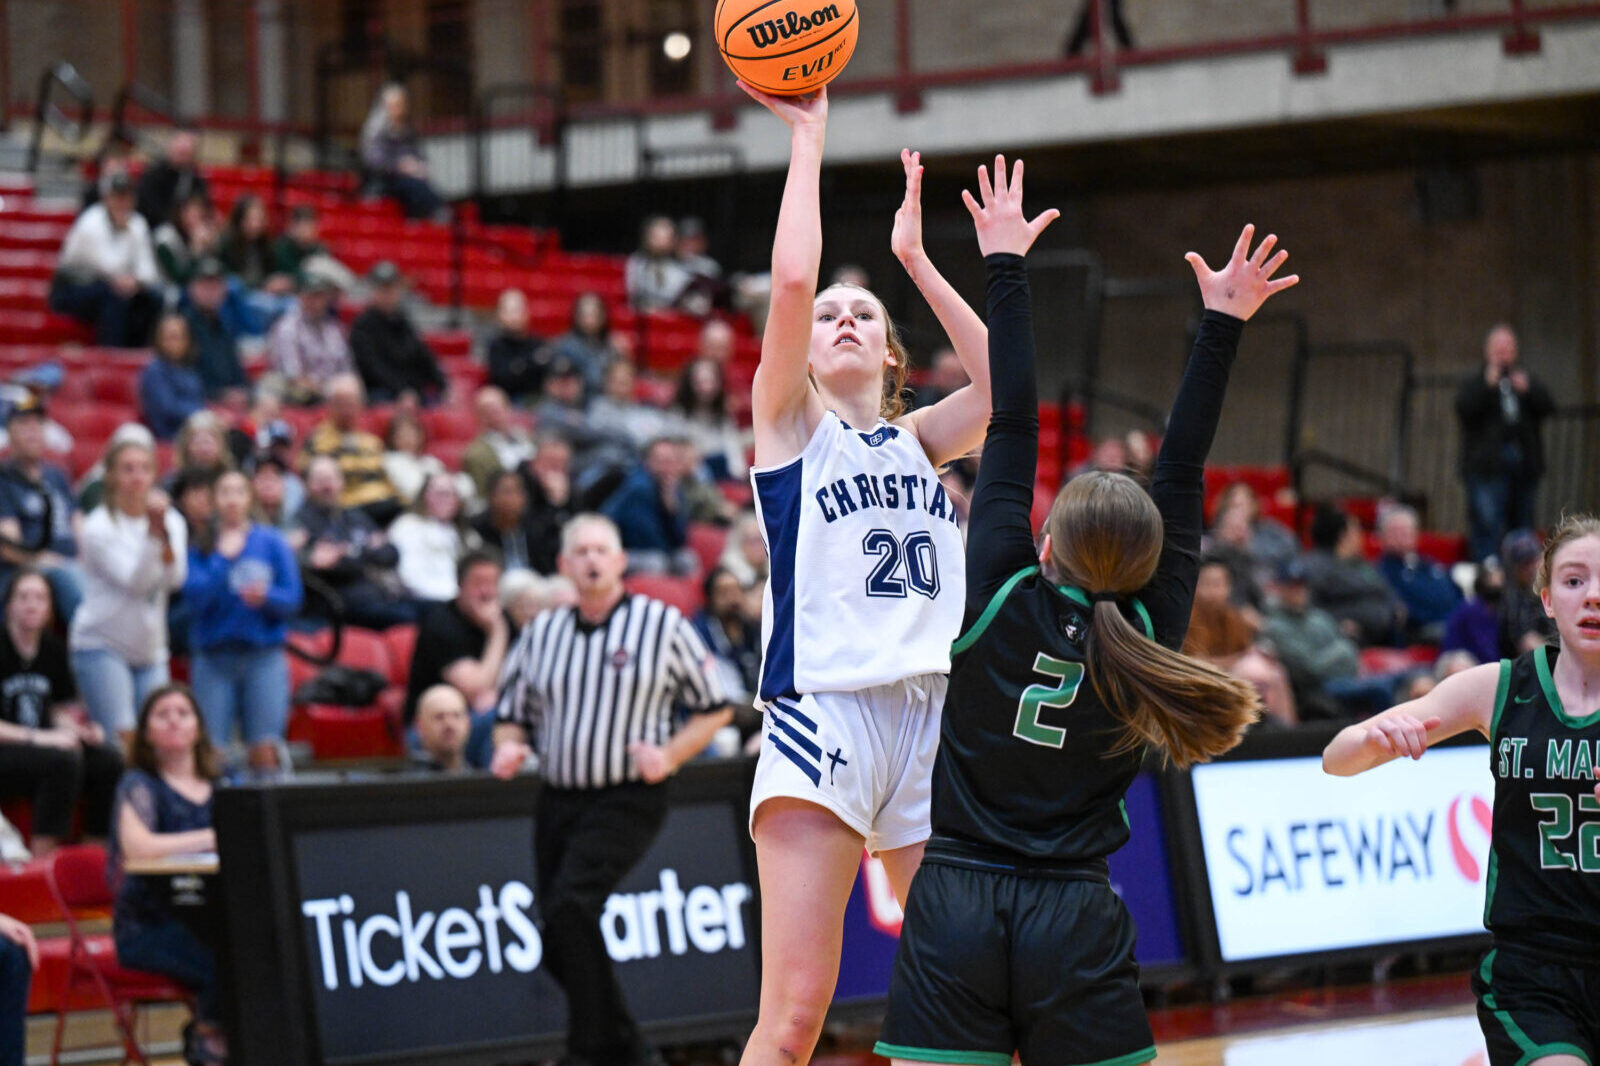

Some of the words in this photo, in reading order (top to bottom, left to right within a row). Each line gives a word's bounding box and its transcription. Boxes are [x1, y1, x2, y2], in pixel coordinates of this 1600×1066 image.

[747, 4, 840, 48] Wilson
[782, 51, 833, 80] EVO
[862, 529, 940, 600] 20
[1013, 651, 1085, 749] 2
[1499, 738, 1534, 778] ST.
[1546, 739, 1600, 780] MA
[1226, 811, 1435, 896] SAFEWAY
[302, 868, 752, 990] TicketSarter
